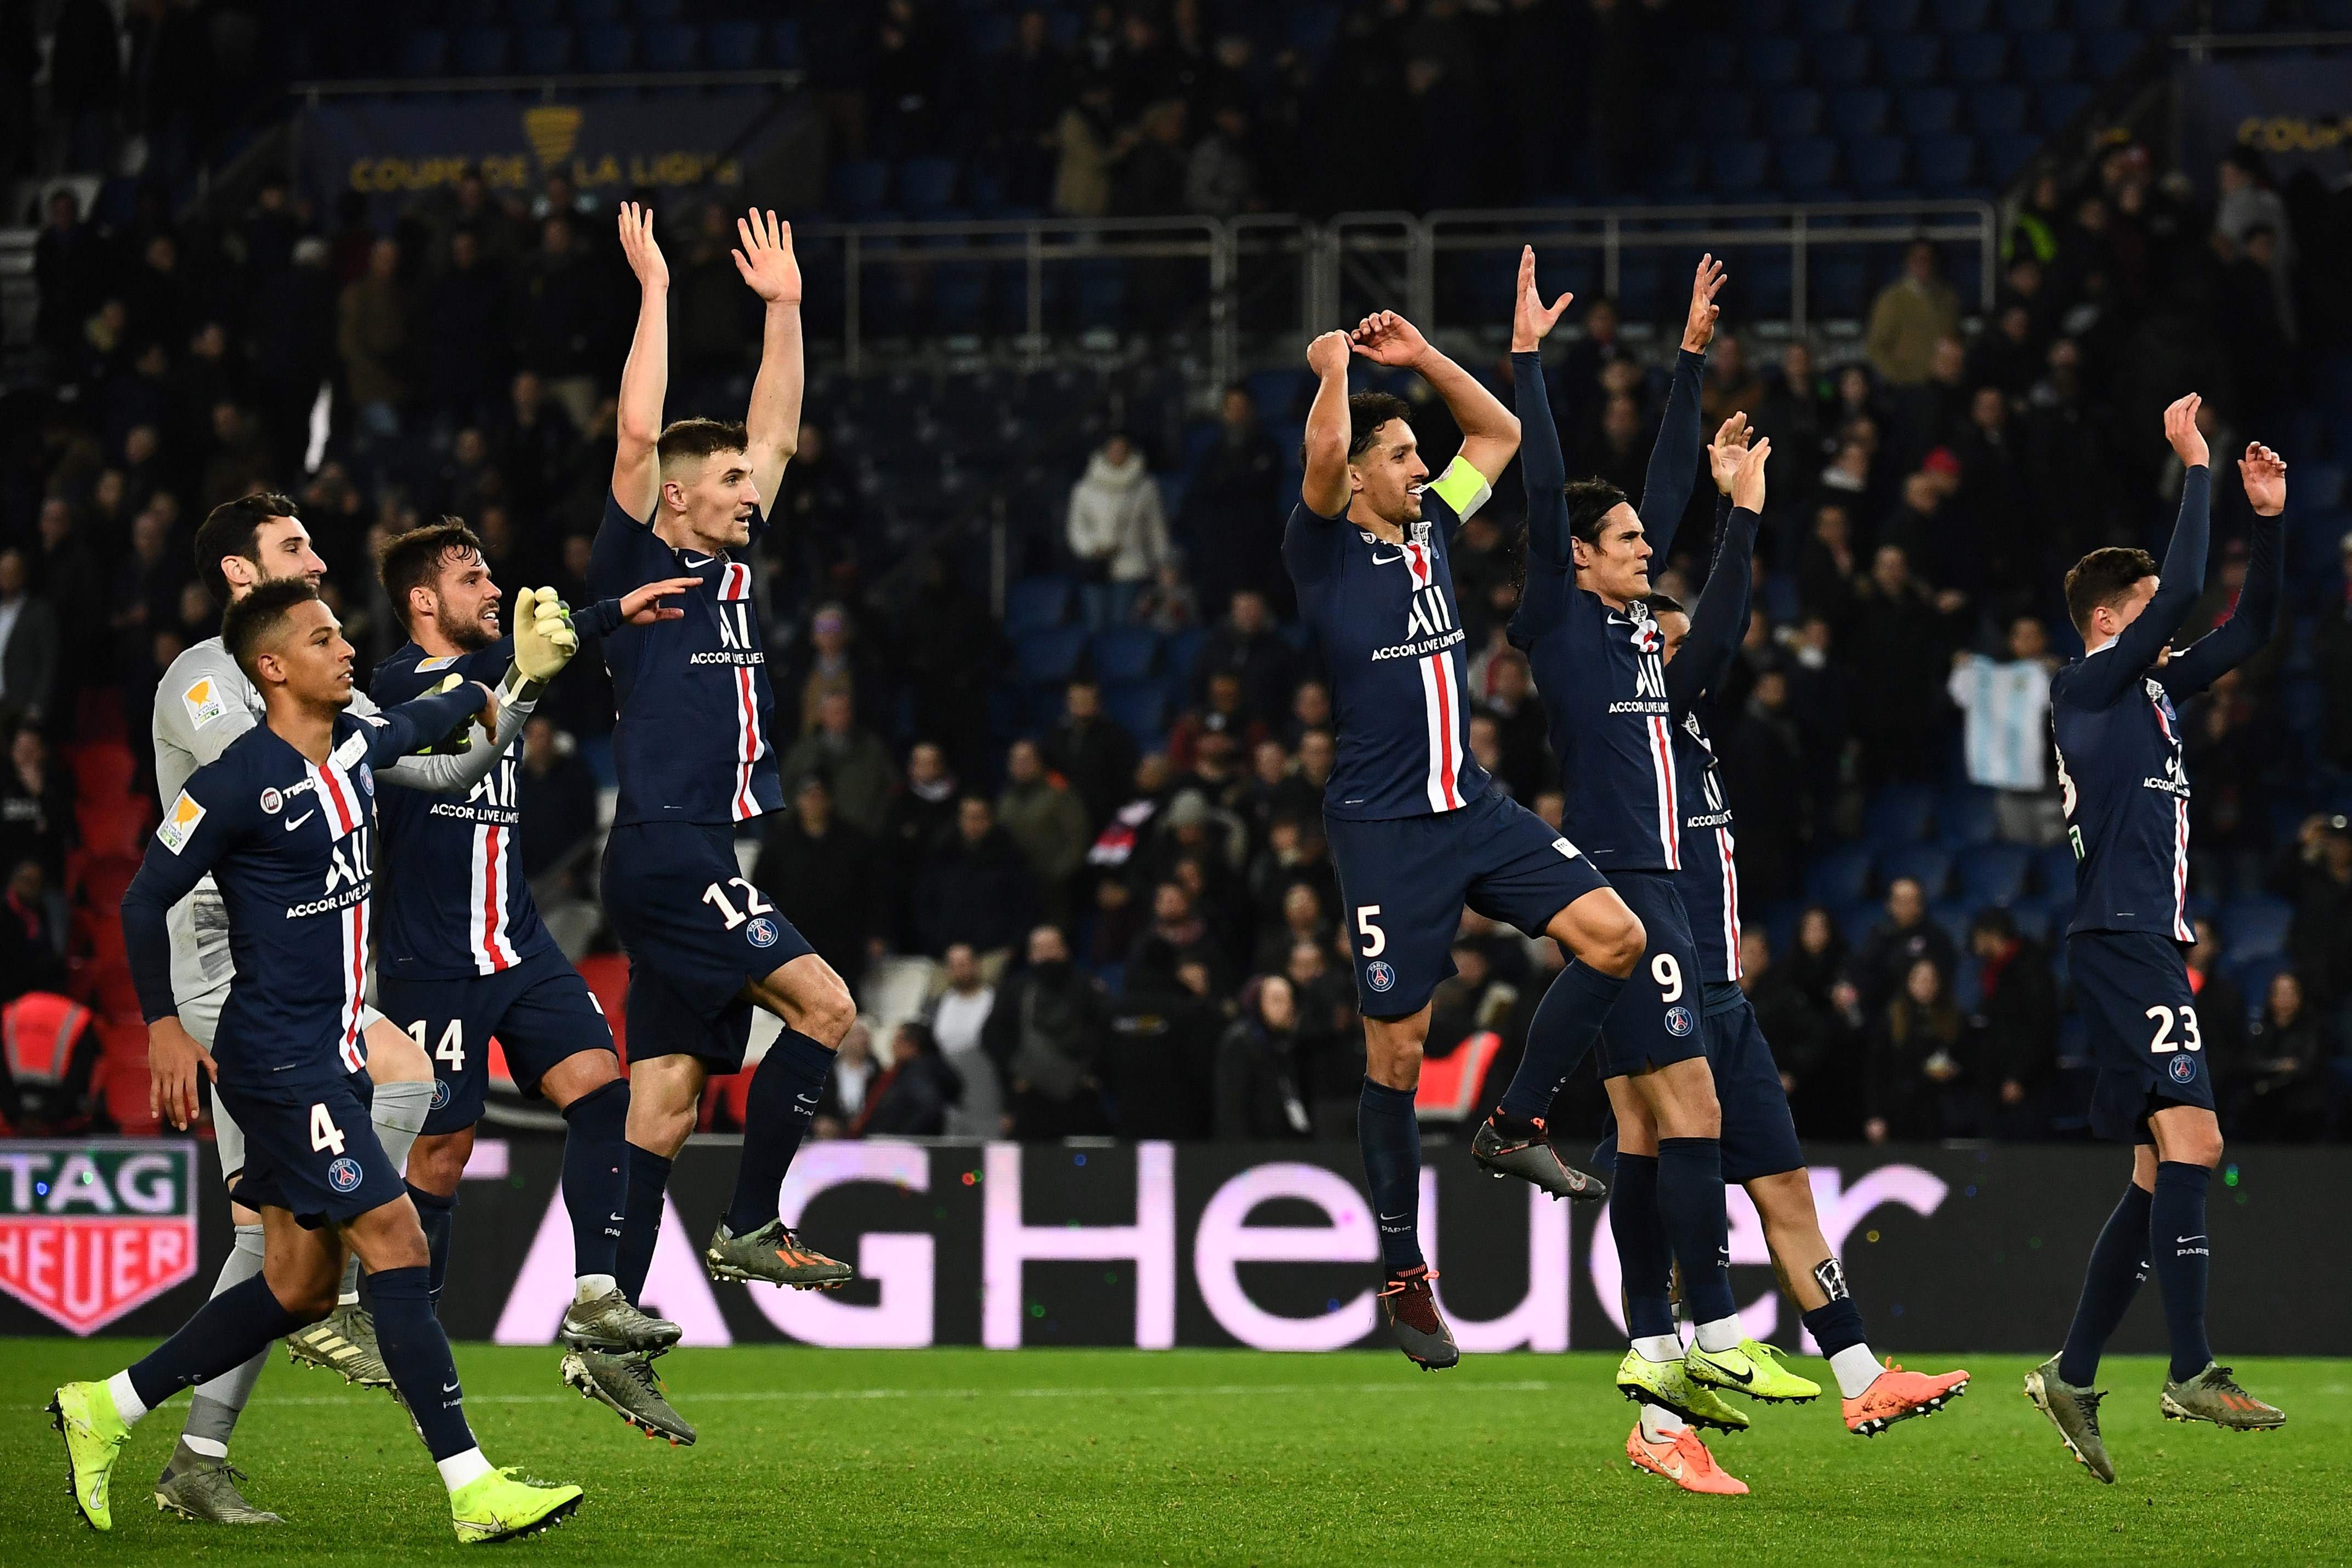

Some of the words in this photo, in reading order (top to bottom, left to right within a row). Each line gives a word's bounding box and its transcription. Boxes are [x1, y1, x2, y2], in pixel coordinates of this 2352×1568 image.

[690, 652, 731, 664] ACCOR
[1371, 644, 1417, 661] ACCOR
[1418, 638, 1439, 654] LIVE
[1609, 701, 1644, 713] ACCOR
[282, 777, 315, 799] TIPO
[2143, 777, 2175, 792] ACCOR
[430, 803, 475, 820] ACCOR
[477, 808, 499, 822] LIVE
[286, 897, 338, 919] ACCOR
[339, 887, 362, 906] LIVE
[702, 877, 774, 930] 12
[748, 919, 766, 932] PARIS
[1357, 905, 1385, 958] 5
[1370, 962, 1387, 972] PARIS
[1651, 953, 1683, 1002] 9
[2145, 1005, 2202, 1053] 23
[407, 1019, 465, 1071] 14
[311, 1102, 345, 1156] 4
[330, 1160, 351, 1174] PARIS
[0, 1153, 176, 1213] TAG
